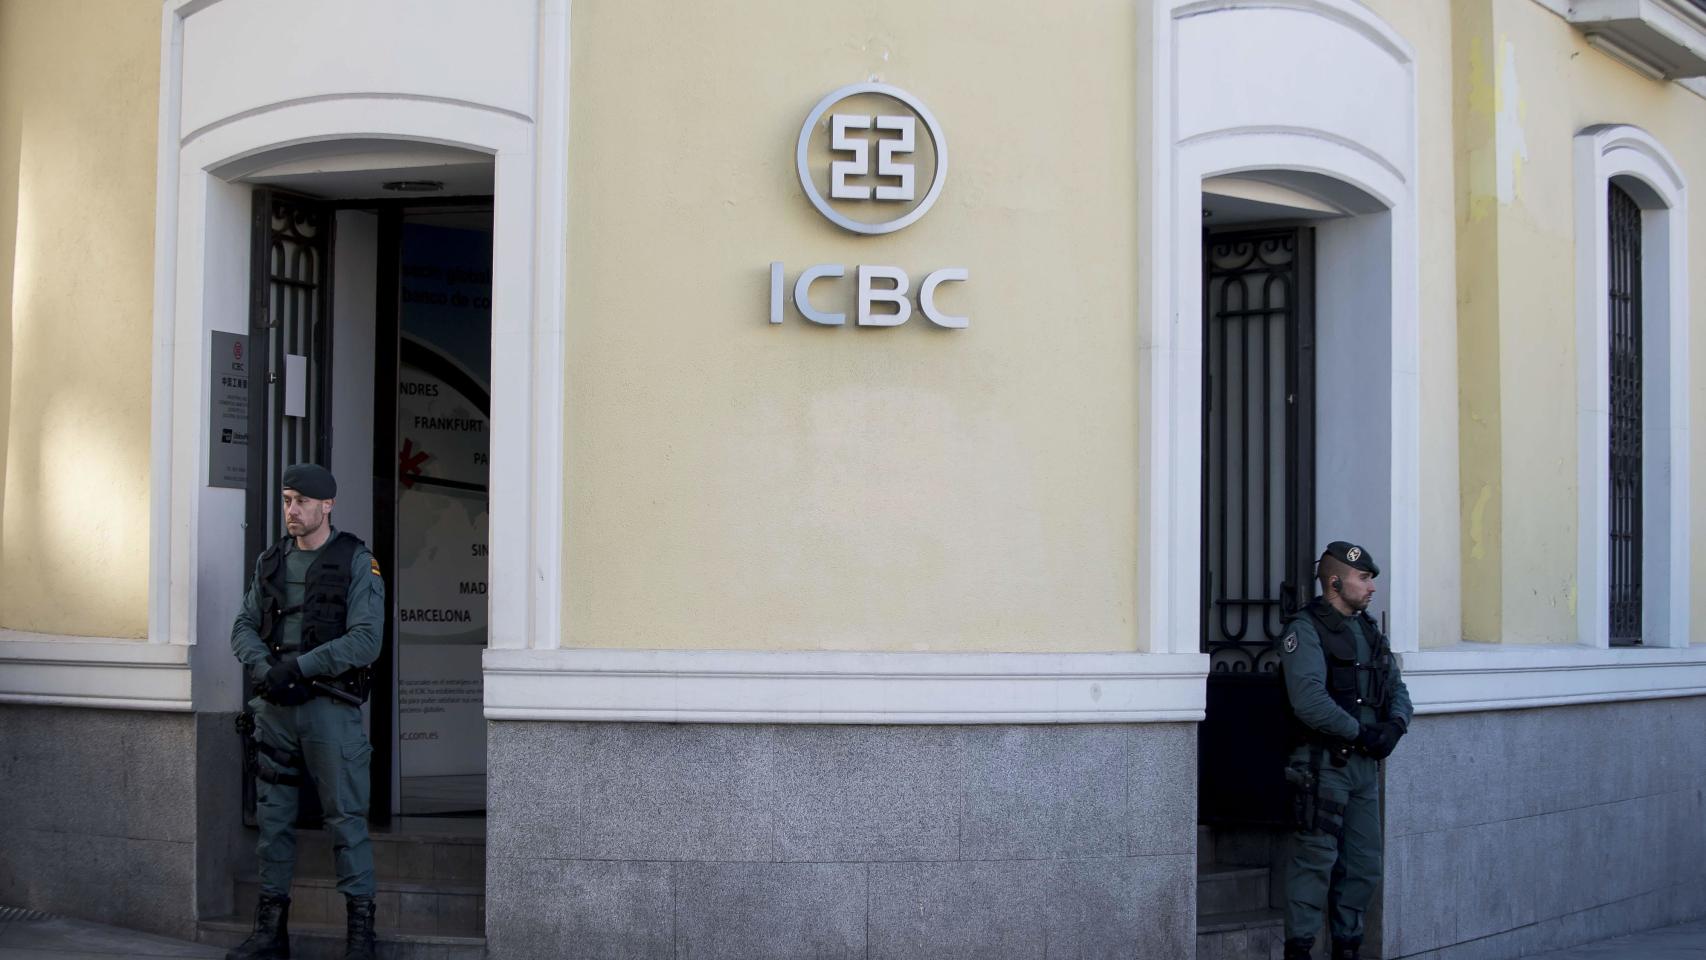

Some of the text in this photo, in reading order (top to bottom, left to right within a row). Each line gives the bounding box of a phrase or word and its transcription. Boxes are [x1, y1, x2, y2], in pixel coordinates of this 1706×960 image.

[769, 261, 969, 328] ICBC
[400, 382, 439, 397] NDRES
[414, 416, 483, 433] FRANKFURT
[400, 609, 472, 623] BARCELONA
